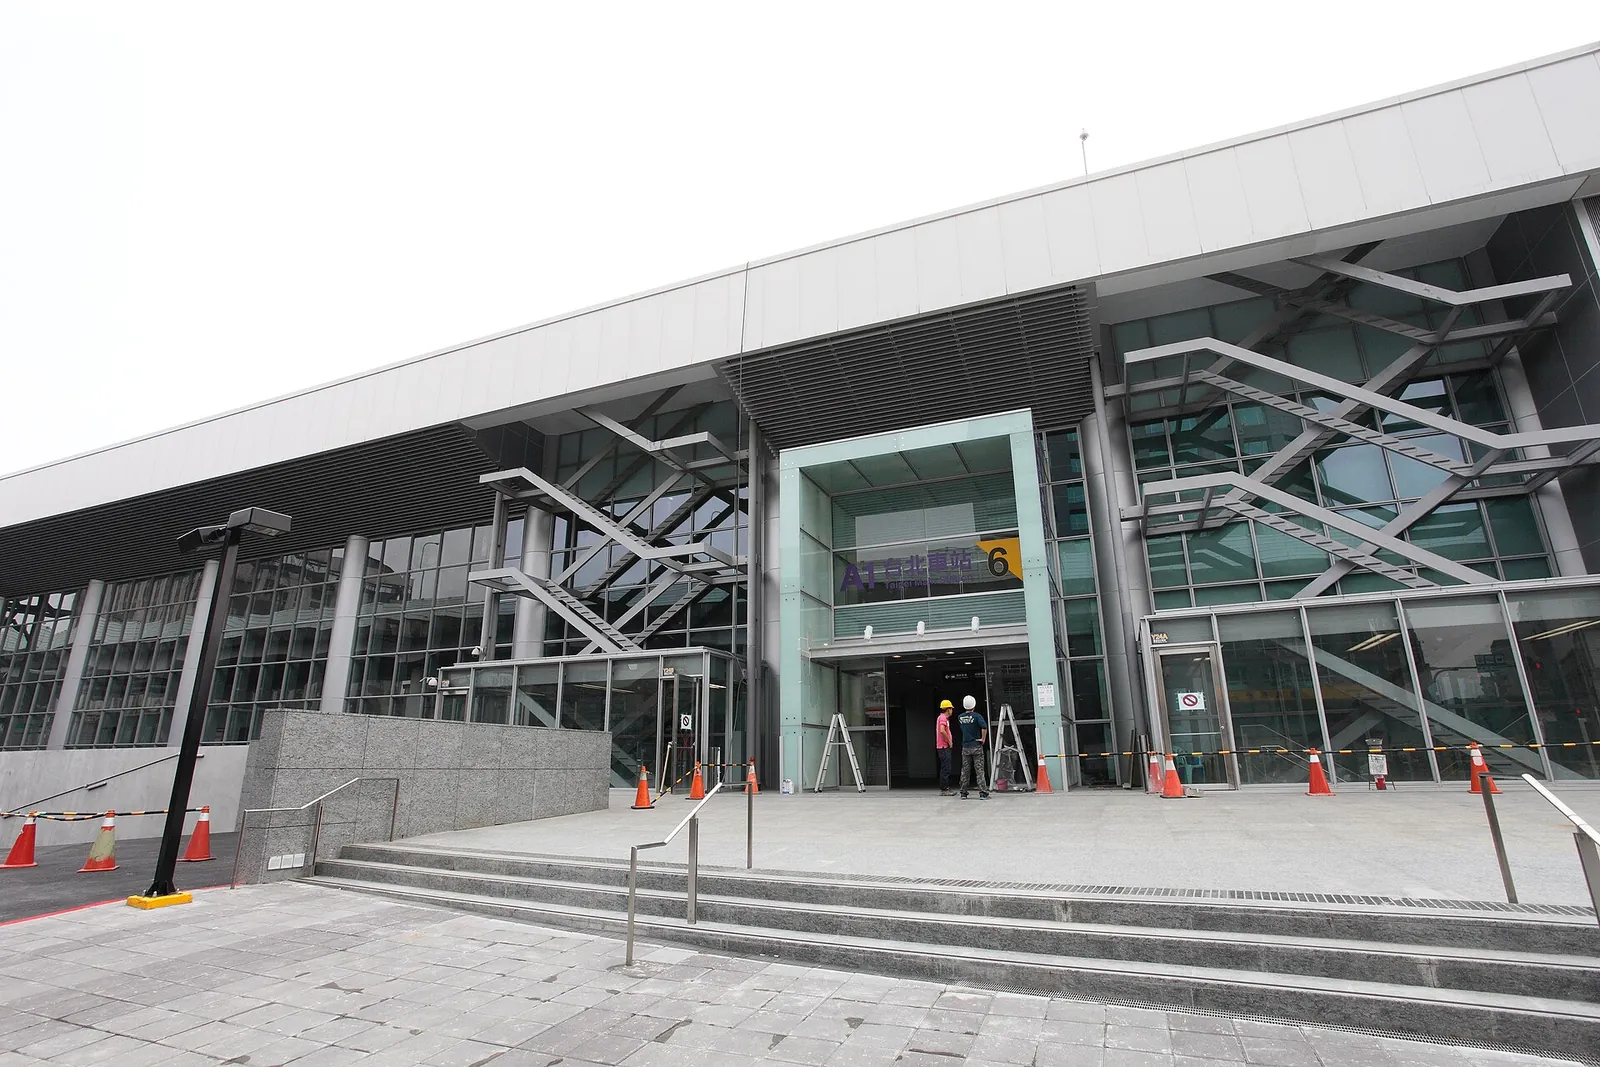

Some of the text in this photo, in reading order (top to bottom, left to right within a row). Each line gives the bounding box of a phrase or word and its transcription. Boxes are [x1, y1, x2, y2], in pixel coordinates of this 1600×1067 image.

[840, 550, 971, 592] A1 台北車站
[987, 547, 1009, 577] 6
